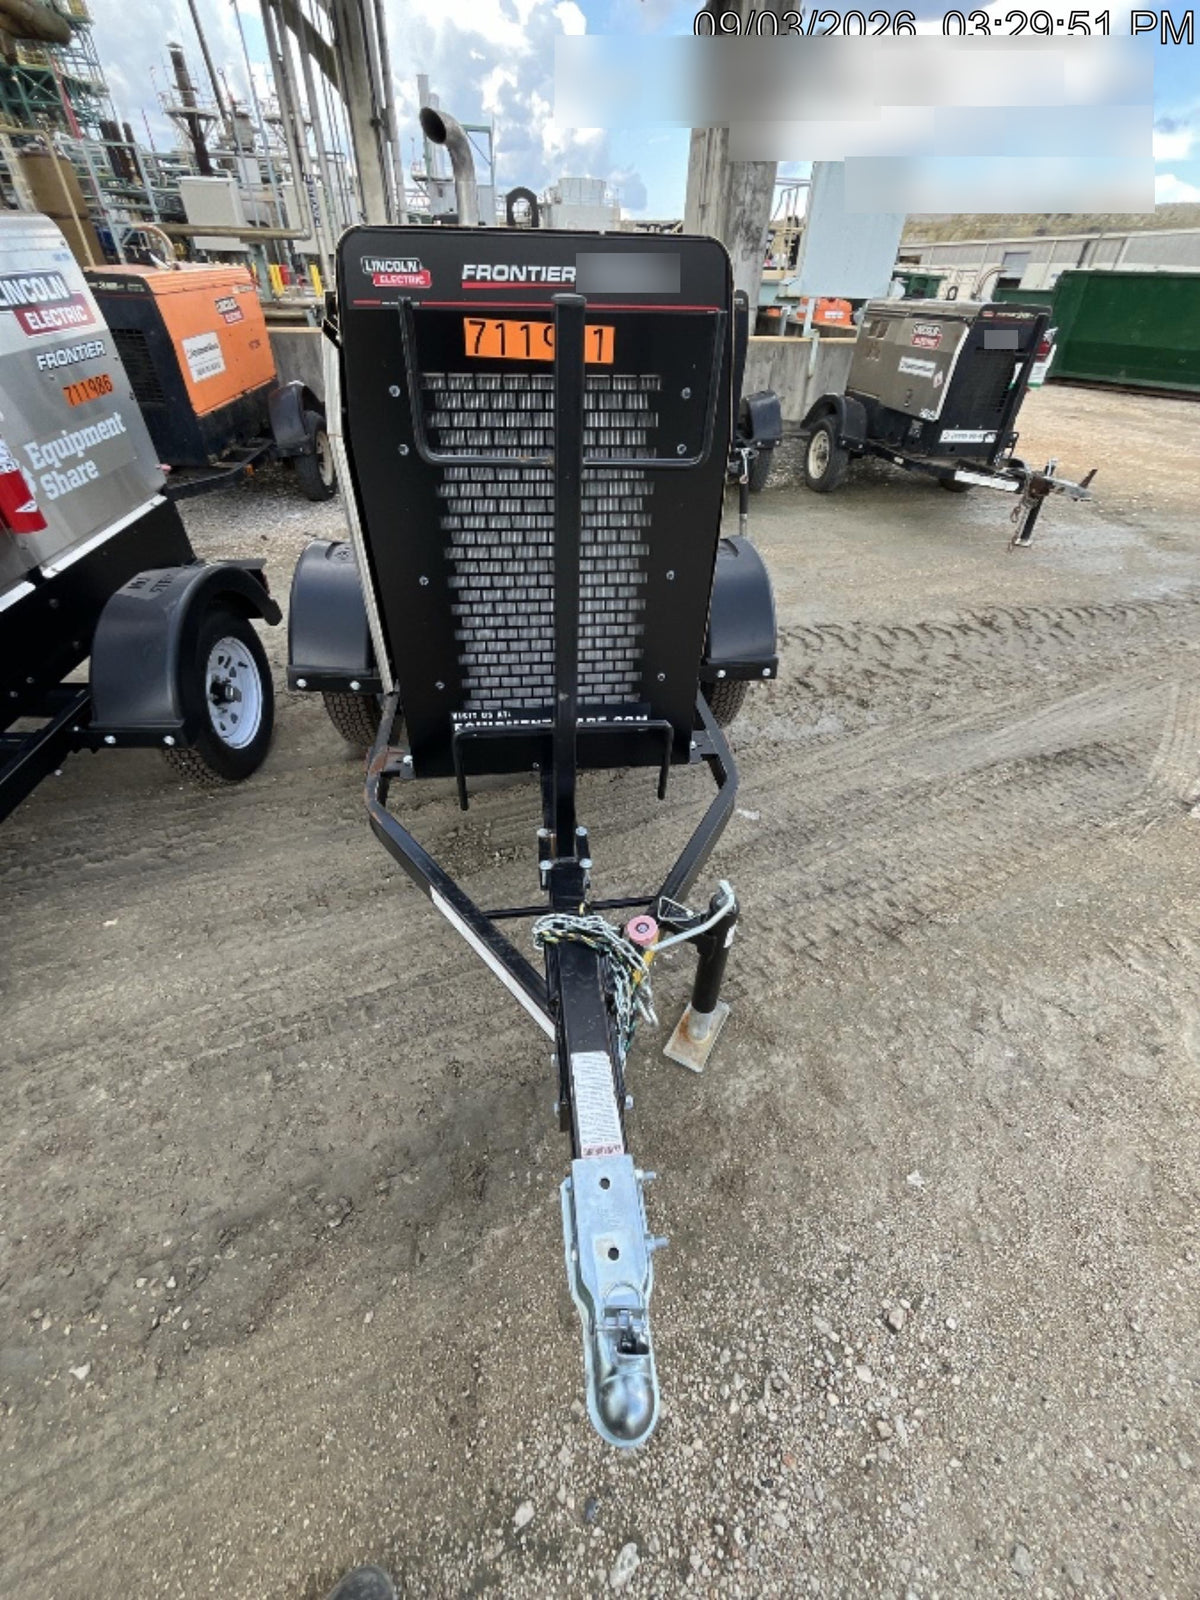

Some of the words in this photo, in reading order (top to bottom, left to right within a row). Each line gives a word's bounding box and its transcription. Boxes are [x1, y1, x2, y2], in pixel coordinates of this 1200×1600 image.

[365, 259, 418, 273] LINCOLN
[379, 274, 426, 286] ELECTRIC
[462, 264, 576, 283] FRONTIER
[24, 304, 88, 330] ELECTRIC
[36, 340, 107, 371] FRONTIER
[469, 319, 604, 361] 71191
[63, 374, 114, 406] 711986
[23, 411, 127, 470] Equipment
[40, 459, 99, 500] Share
